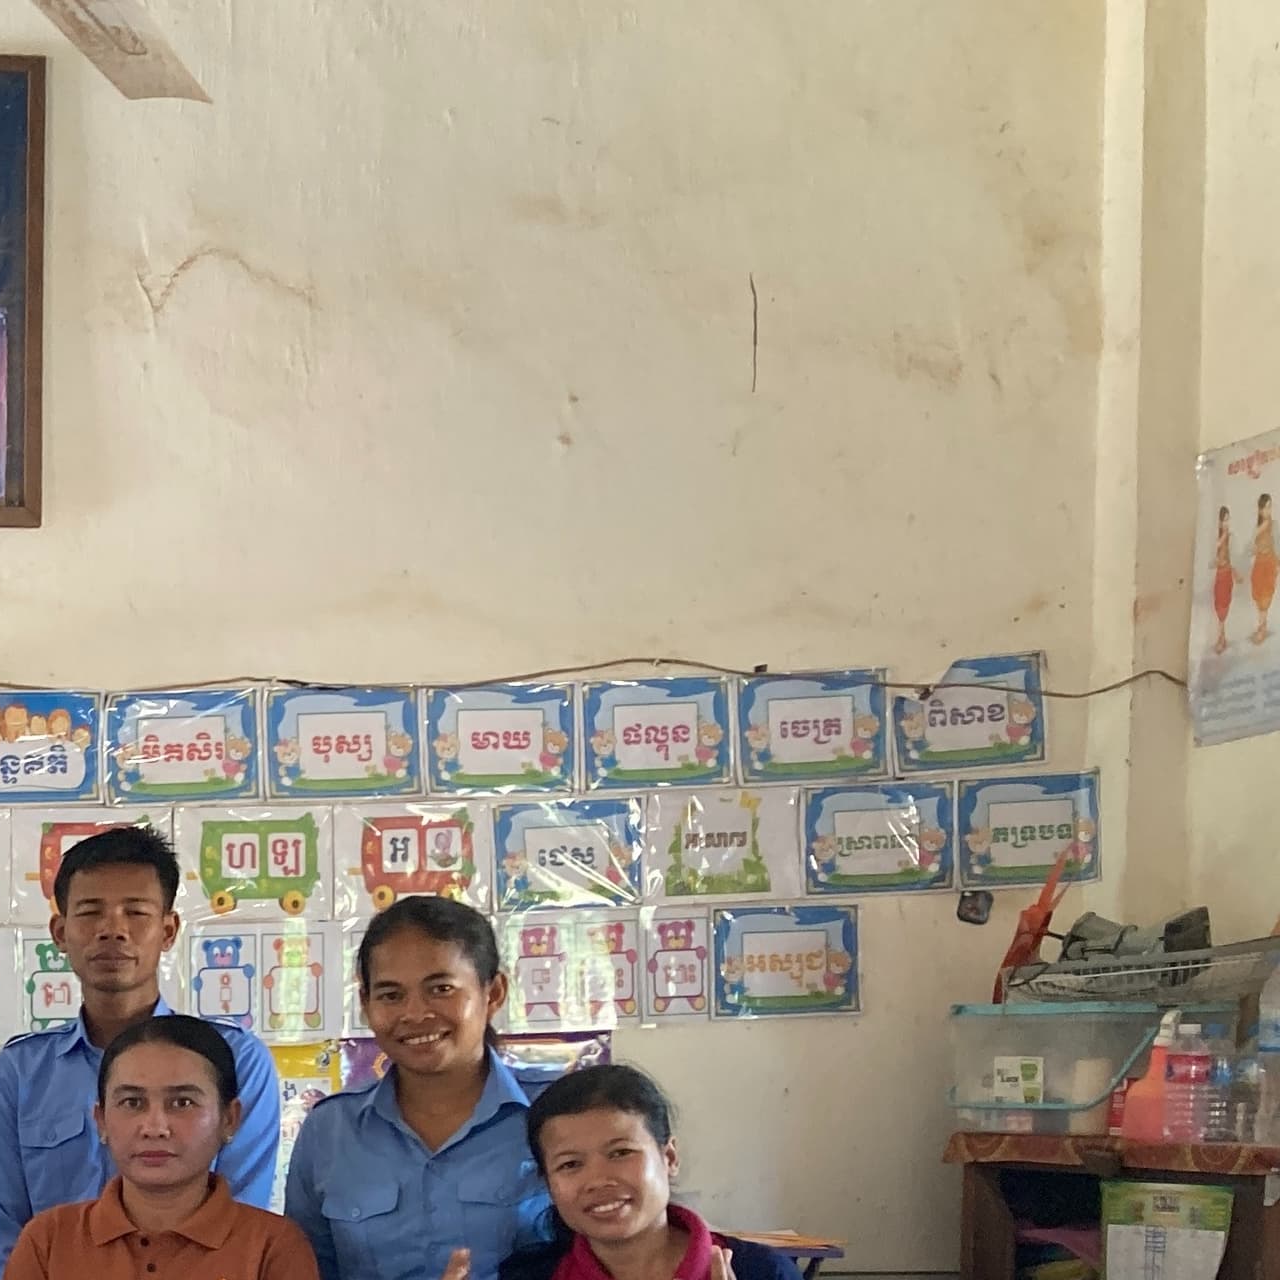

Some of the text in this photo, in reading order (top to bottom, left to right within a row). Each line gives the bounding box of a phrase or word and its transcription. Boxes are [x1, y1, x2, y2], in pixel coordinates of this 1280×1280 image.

[472, 731, 531, 750] មាឃ
[780, 718, 841, 744] ចេត្រ
[225, 839, 300, 875] ហ ឡ
[390, 837, 410, 863] អ
